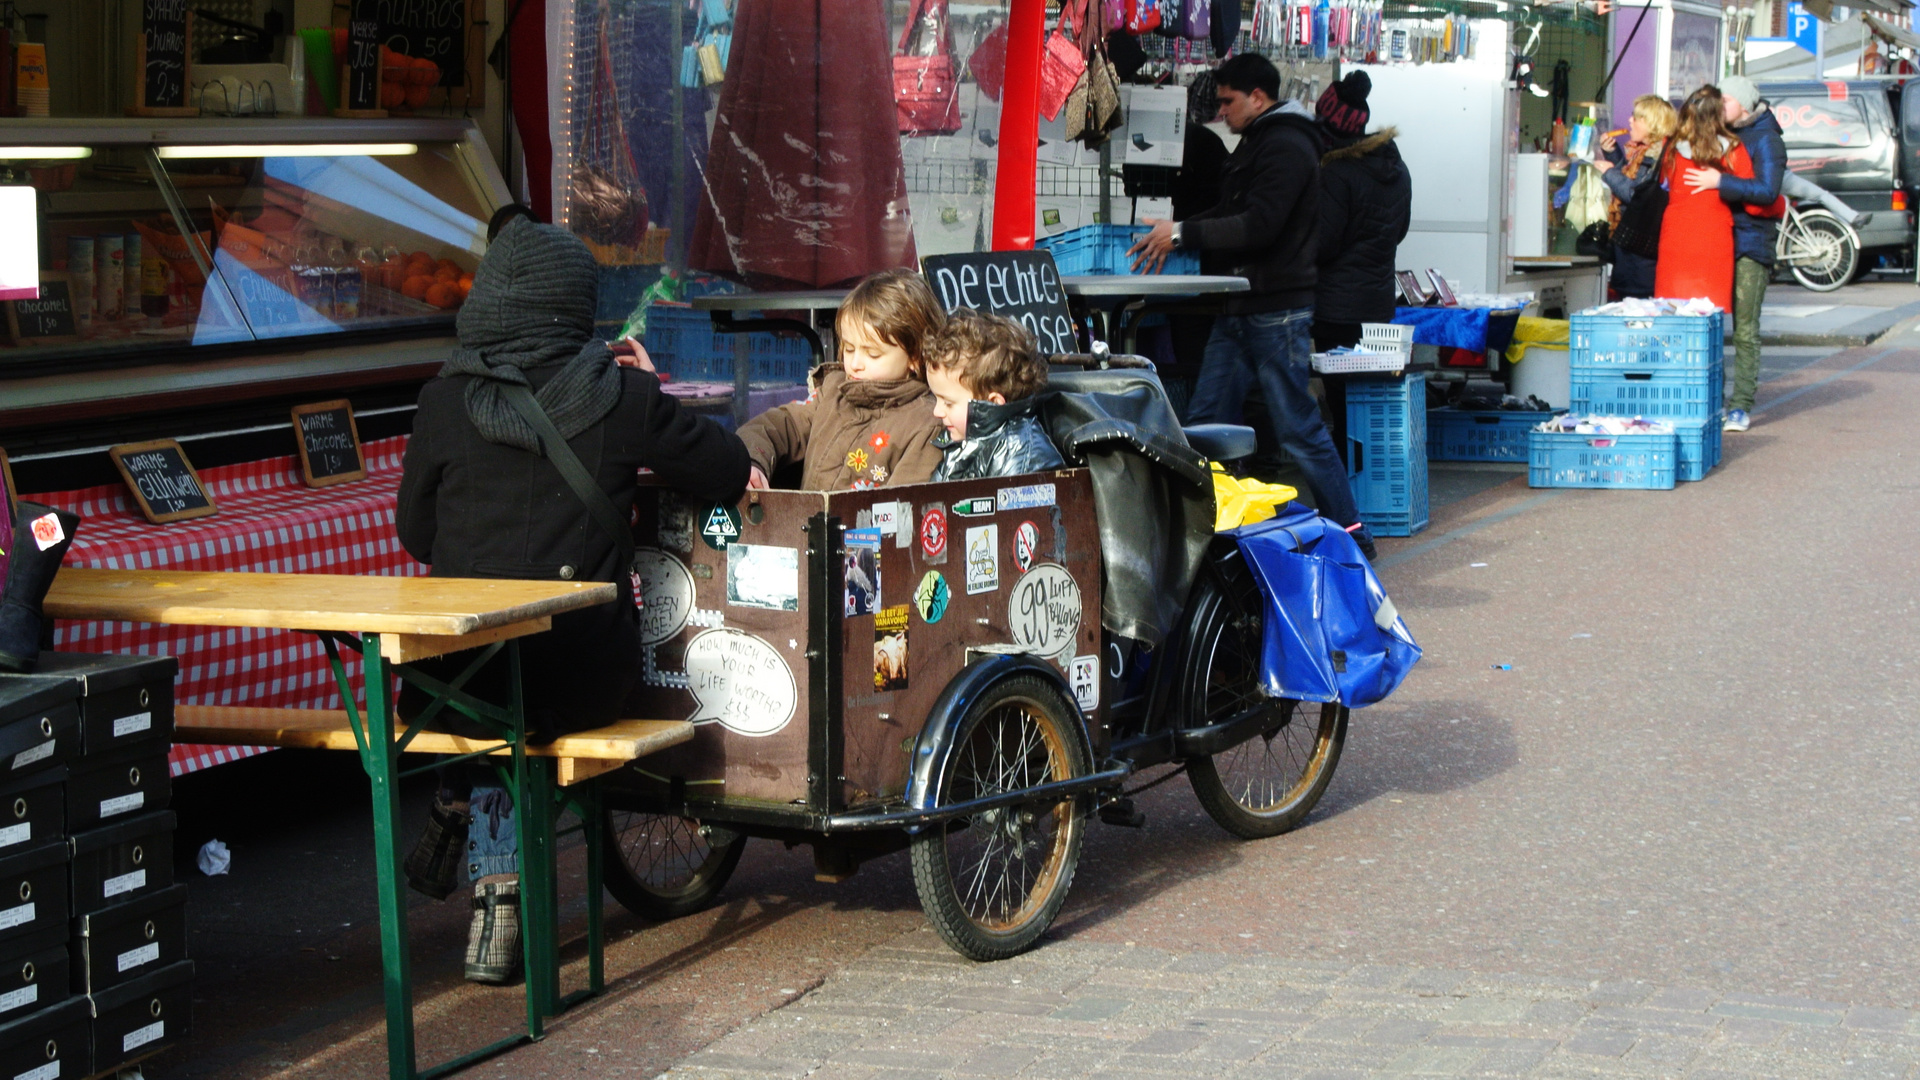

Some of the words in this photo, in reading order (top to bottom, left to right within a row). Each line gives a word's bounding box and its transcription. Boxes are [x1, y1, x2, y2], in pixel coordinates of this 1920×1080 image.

[1795, 17, 1809, 38] P
[352, 41, 376, 69] JUS
[986, 260, 1059, 309] echte
[1020, 578, 1050, 648] 99
[699, 637, 723, 652] HOW
[730, 640, 760, 660] MUCH
[721, 654, 756, 677] YOUR
